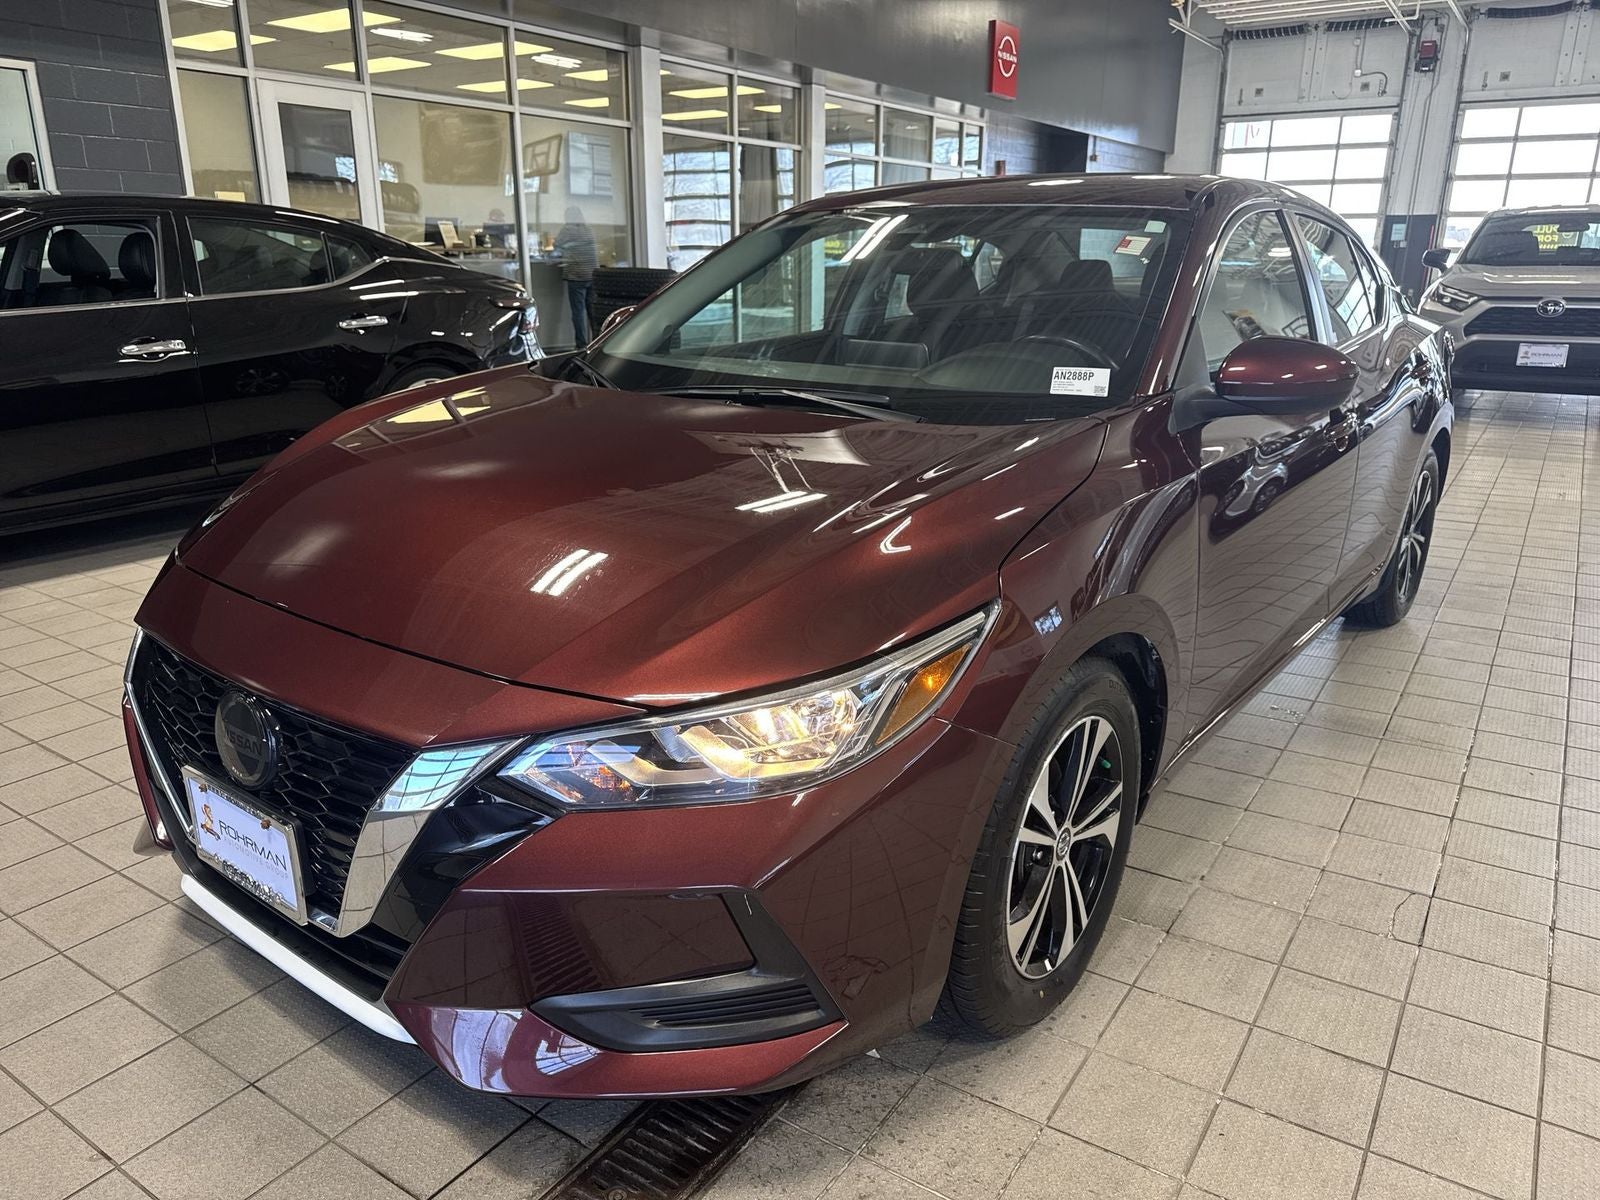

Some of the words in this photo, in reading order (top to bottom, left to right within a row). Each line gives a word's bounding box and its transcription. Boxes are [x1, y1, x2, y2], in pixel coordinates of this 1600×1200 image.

[998, 50, 1017, 63] NISSAN
[1053, 371, 1095, 381] AN2888P
[219, 819, 287, 871] ROHRMAN
